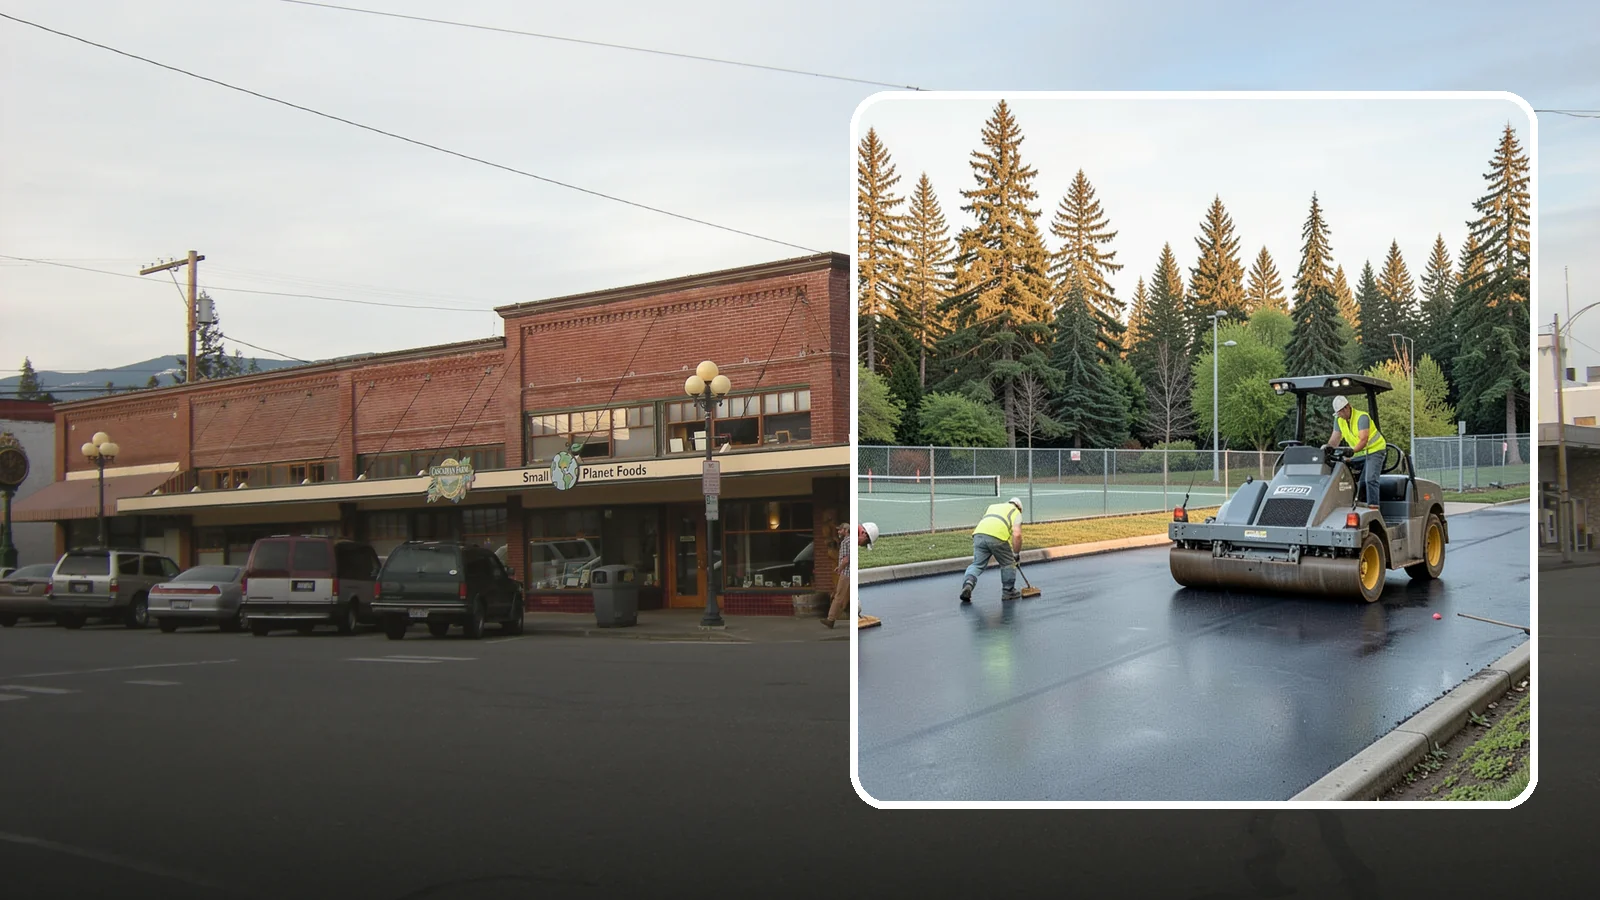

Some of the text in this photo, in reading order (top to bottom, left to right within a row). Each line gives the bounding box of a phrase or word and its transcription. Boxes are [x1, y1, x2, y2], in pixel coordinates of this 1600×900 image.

[523, 464, 647, 483] Small Planet Foods
